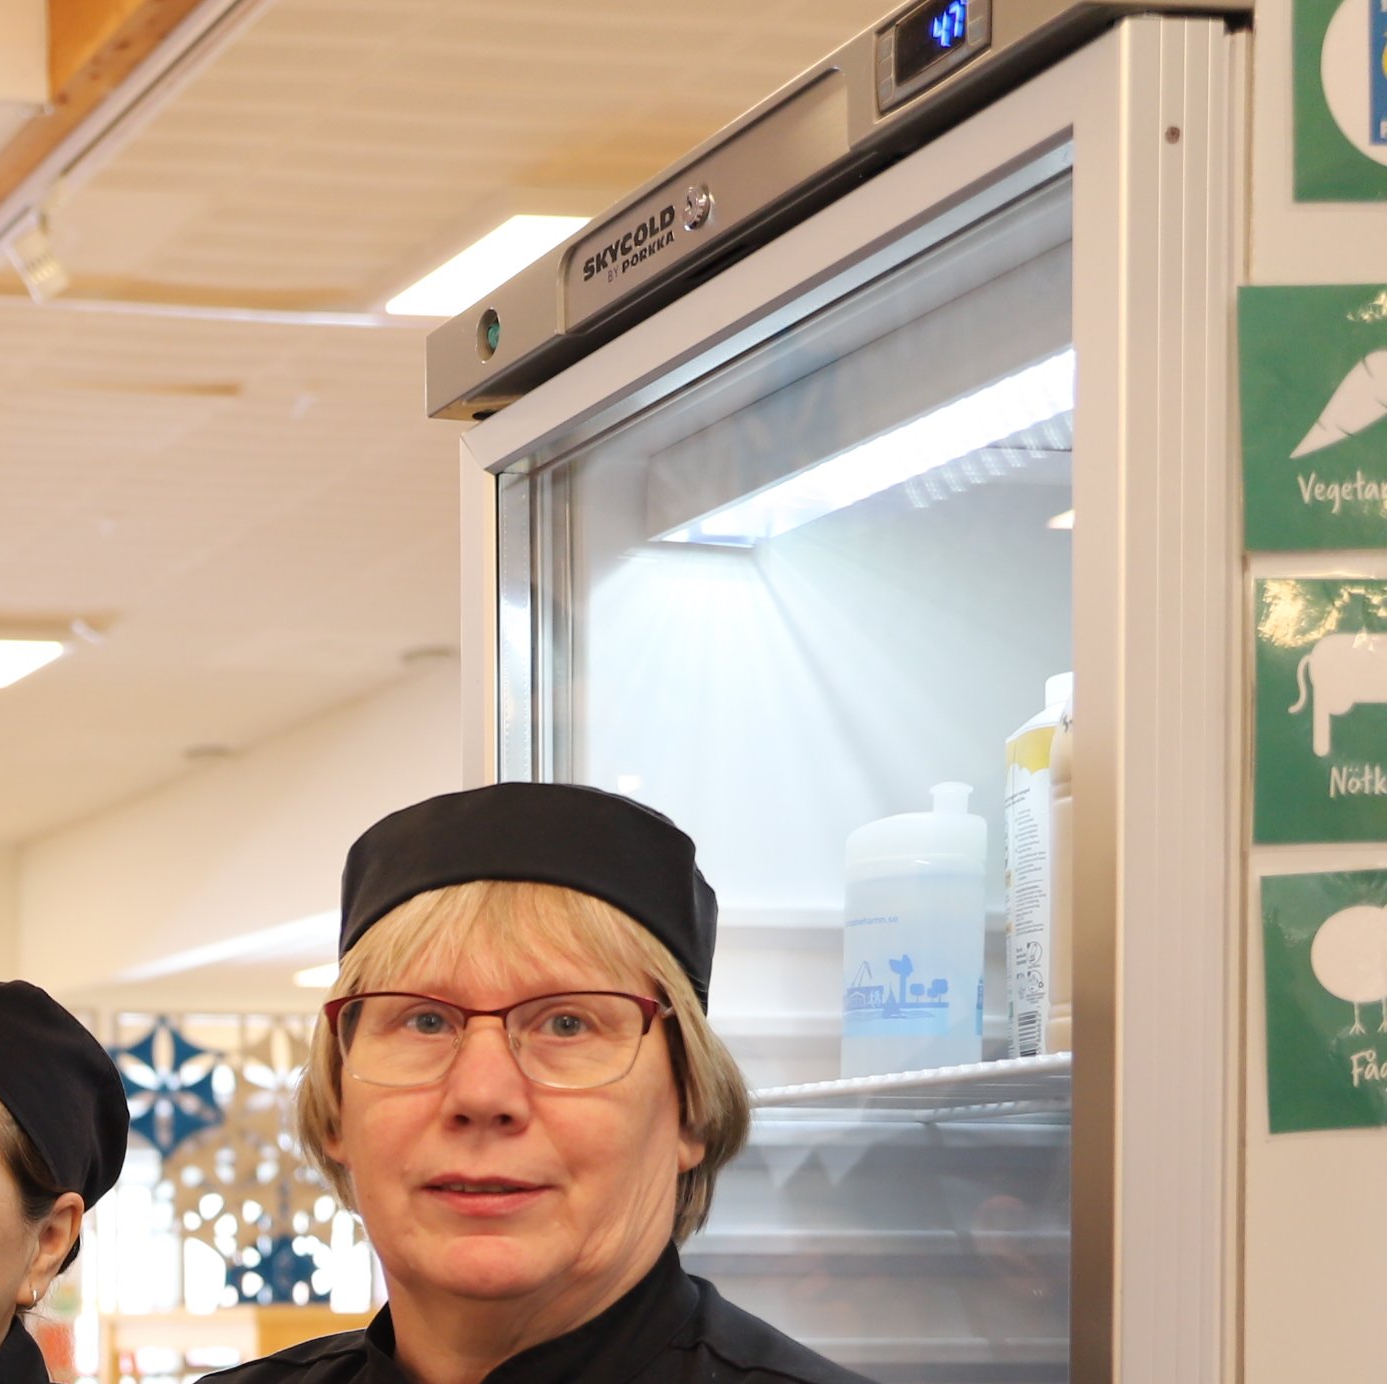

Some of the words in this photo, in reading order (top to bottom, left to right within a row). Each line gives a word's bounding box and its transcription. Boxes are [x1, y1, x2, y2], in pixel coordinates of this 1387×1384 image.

[583, 205, 675, 282] SKYCOLD
[607, 267, 619, 283] BY
[622, 230, 675, 273] PORKKA
[1330, 764, 1387, 798] Nötk
